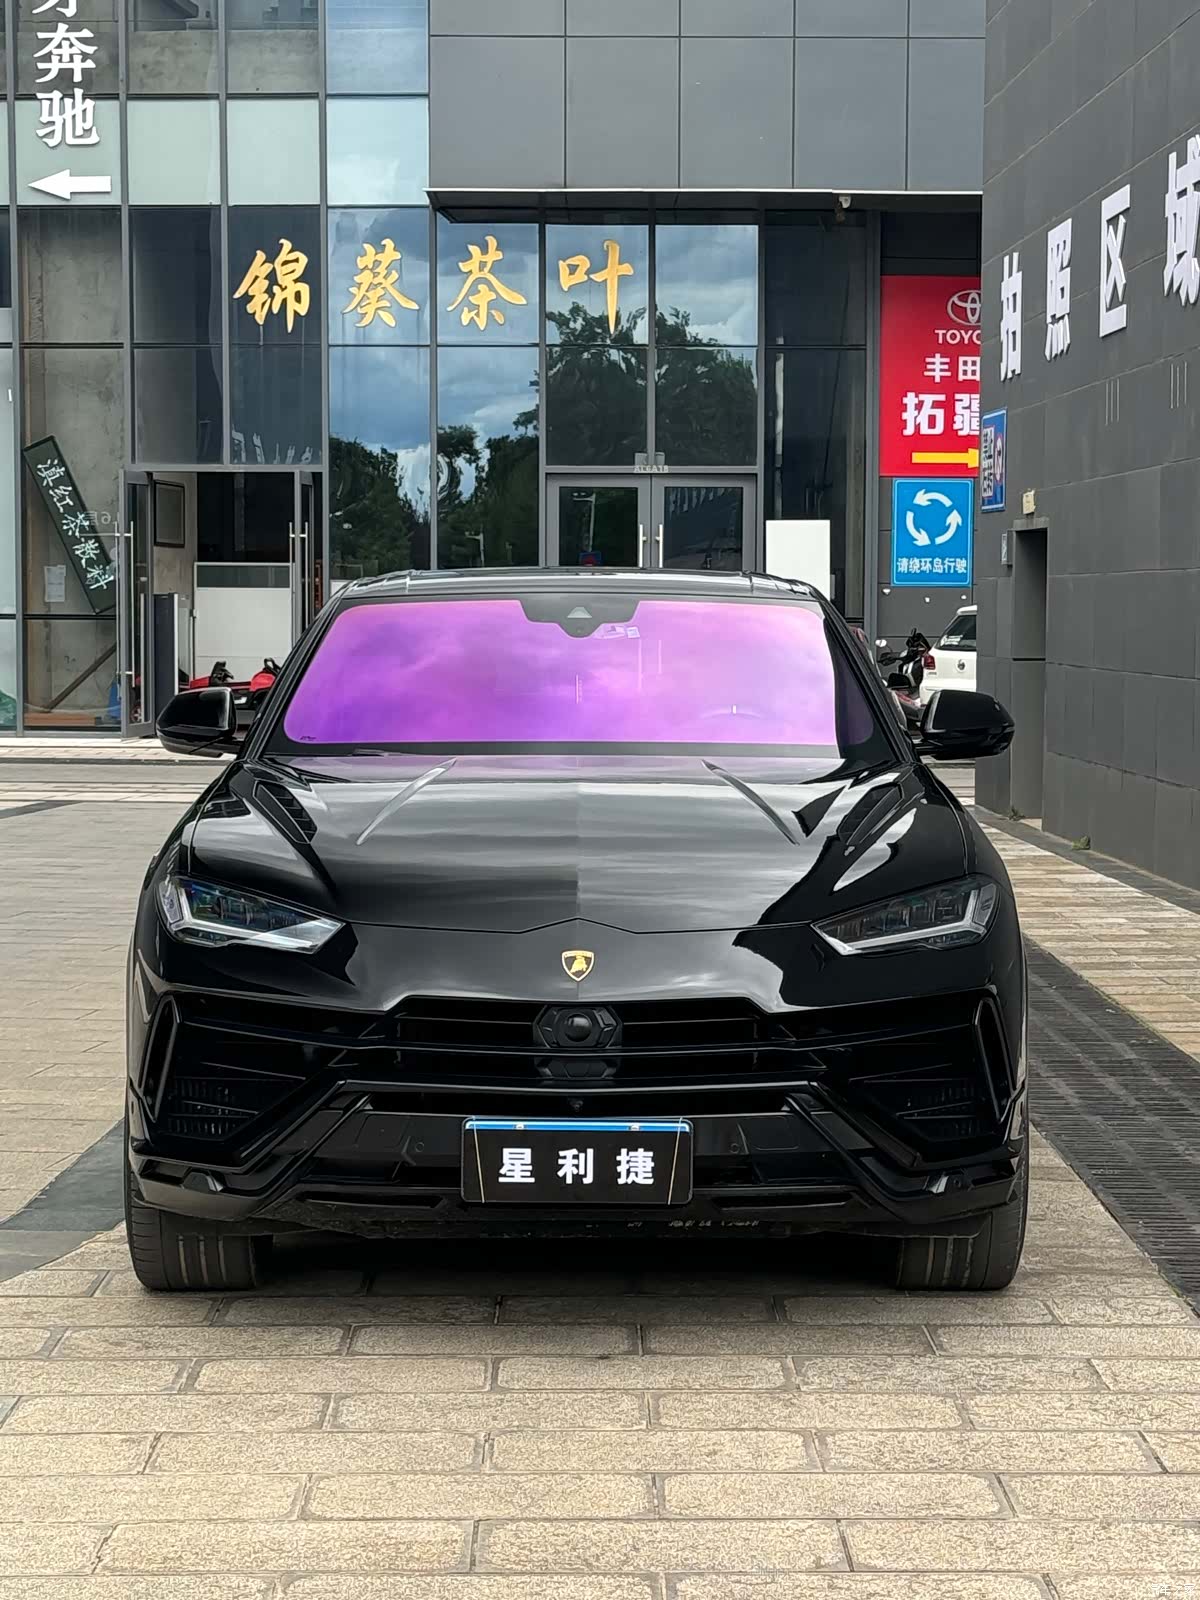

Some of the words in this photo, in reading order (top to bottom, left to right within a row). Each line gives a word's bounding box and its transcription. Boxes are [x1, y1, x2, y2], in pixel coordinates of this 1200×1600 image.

[32, 0, 101, 148] 奔驰
[233, 235, 634, 334] 锦葵茶叶
[1000, 134, 1200, 382] 拍照区域
[924, 353, 981, 383] 丰田
[897, 557, 968, 574] 请绕环岛行驶
[498, 1147, 655, 1185] 星利捷
